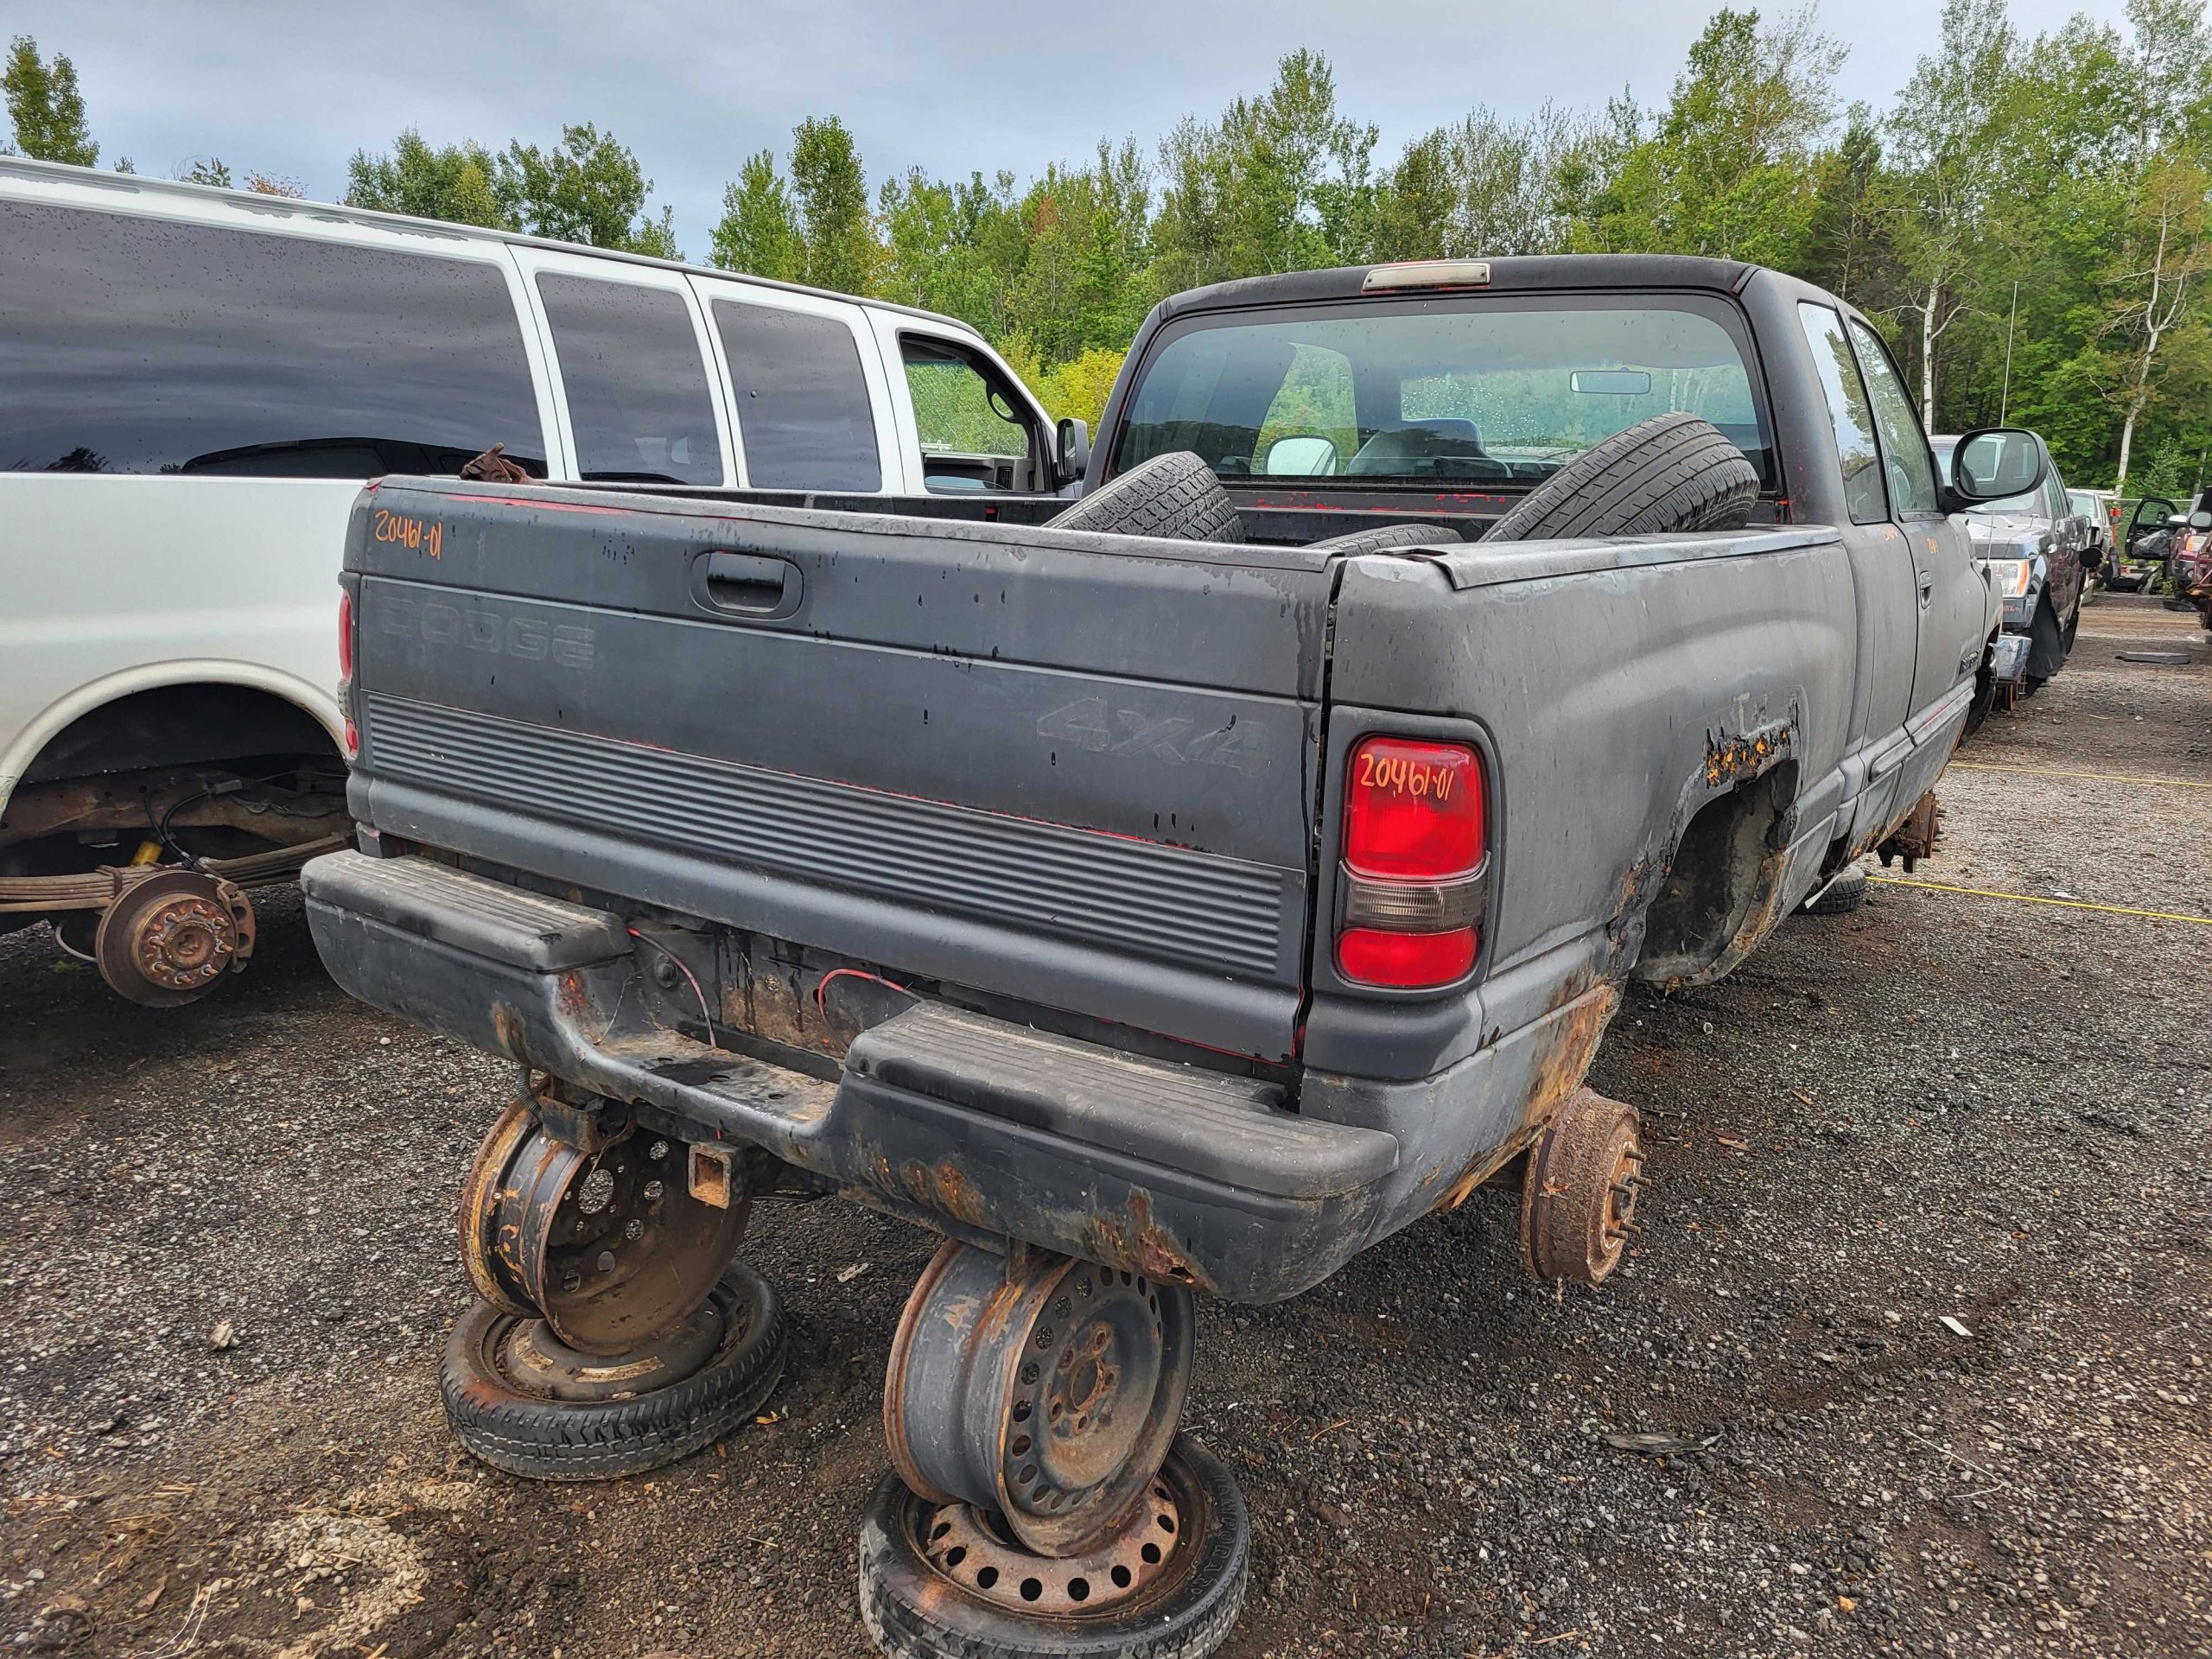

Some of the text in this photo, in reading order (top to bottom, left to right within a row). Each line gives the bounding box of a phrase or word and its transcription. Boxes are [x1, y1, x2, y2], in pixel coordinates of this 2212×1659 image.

[375, 509, 442, 561] 20461-01
[381, 596, 595, 670] DODGE
[1360, 753, 1455, 802] 20461-01
[1189, 1474, 1240, 1602] TEMPORAR
